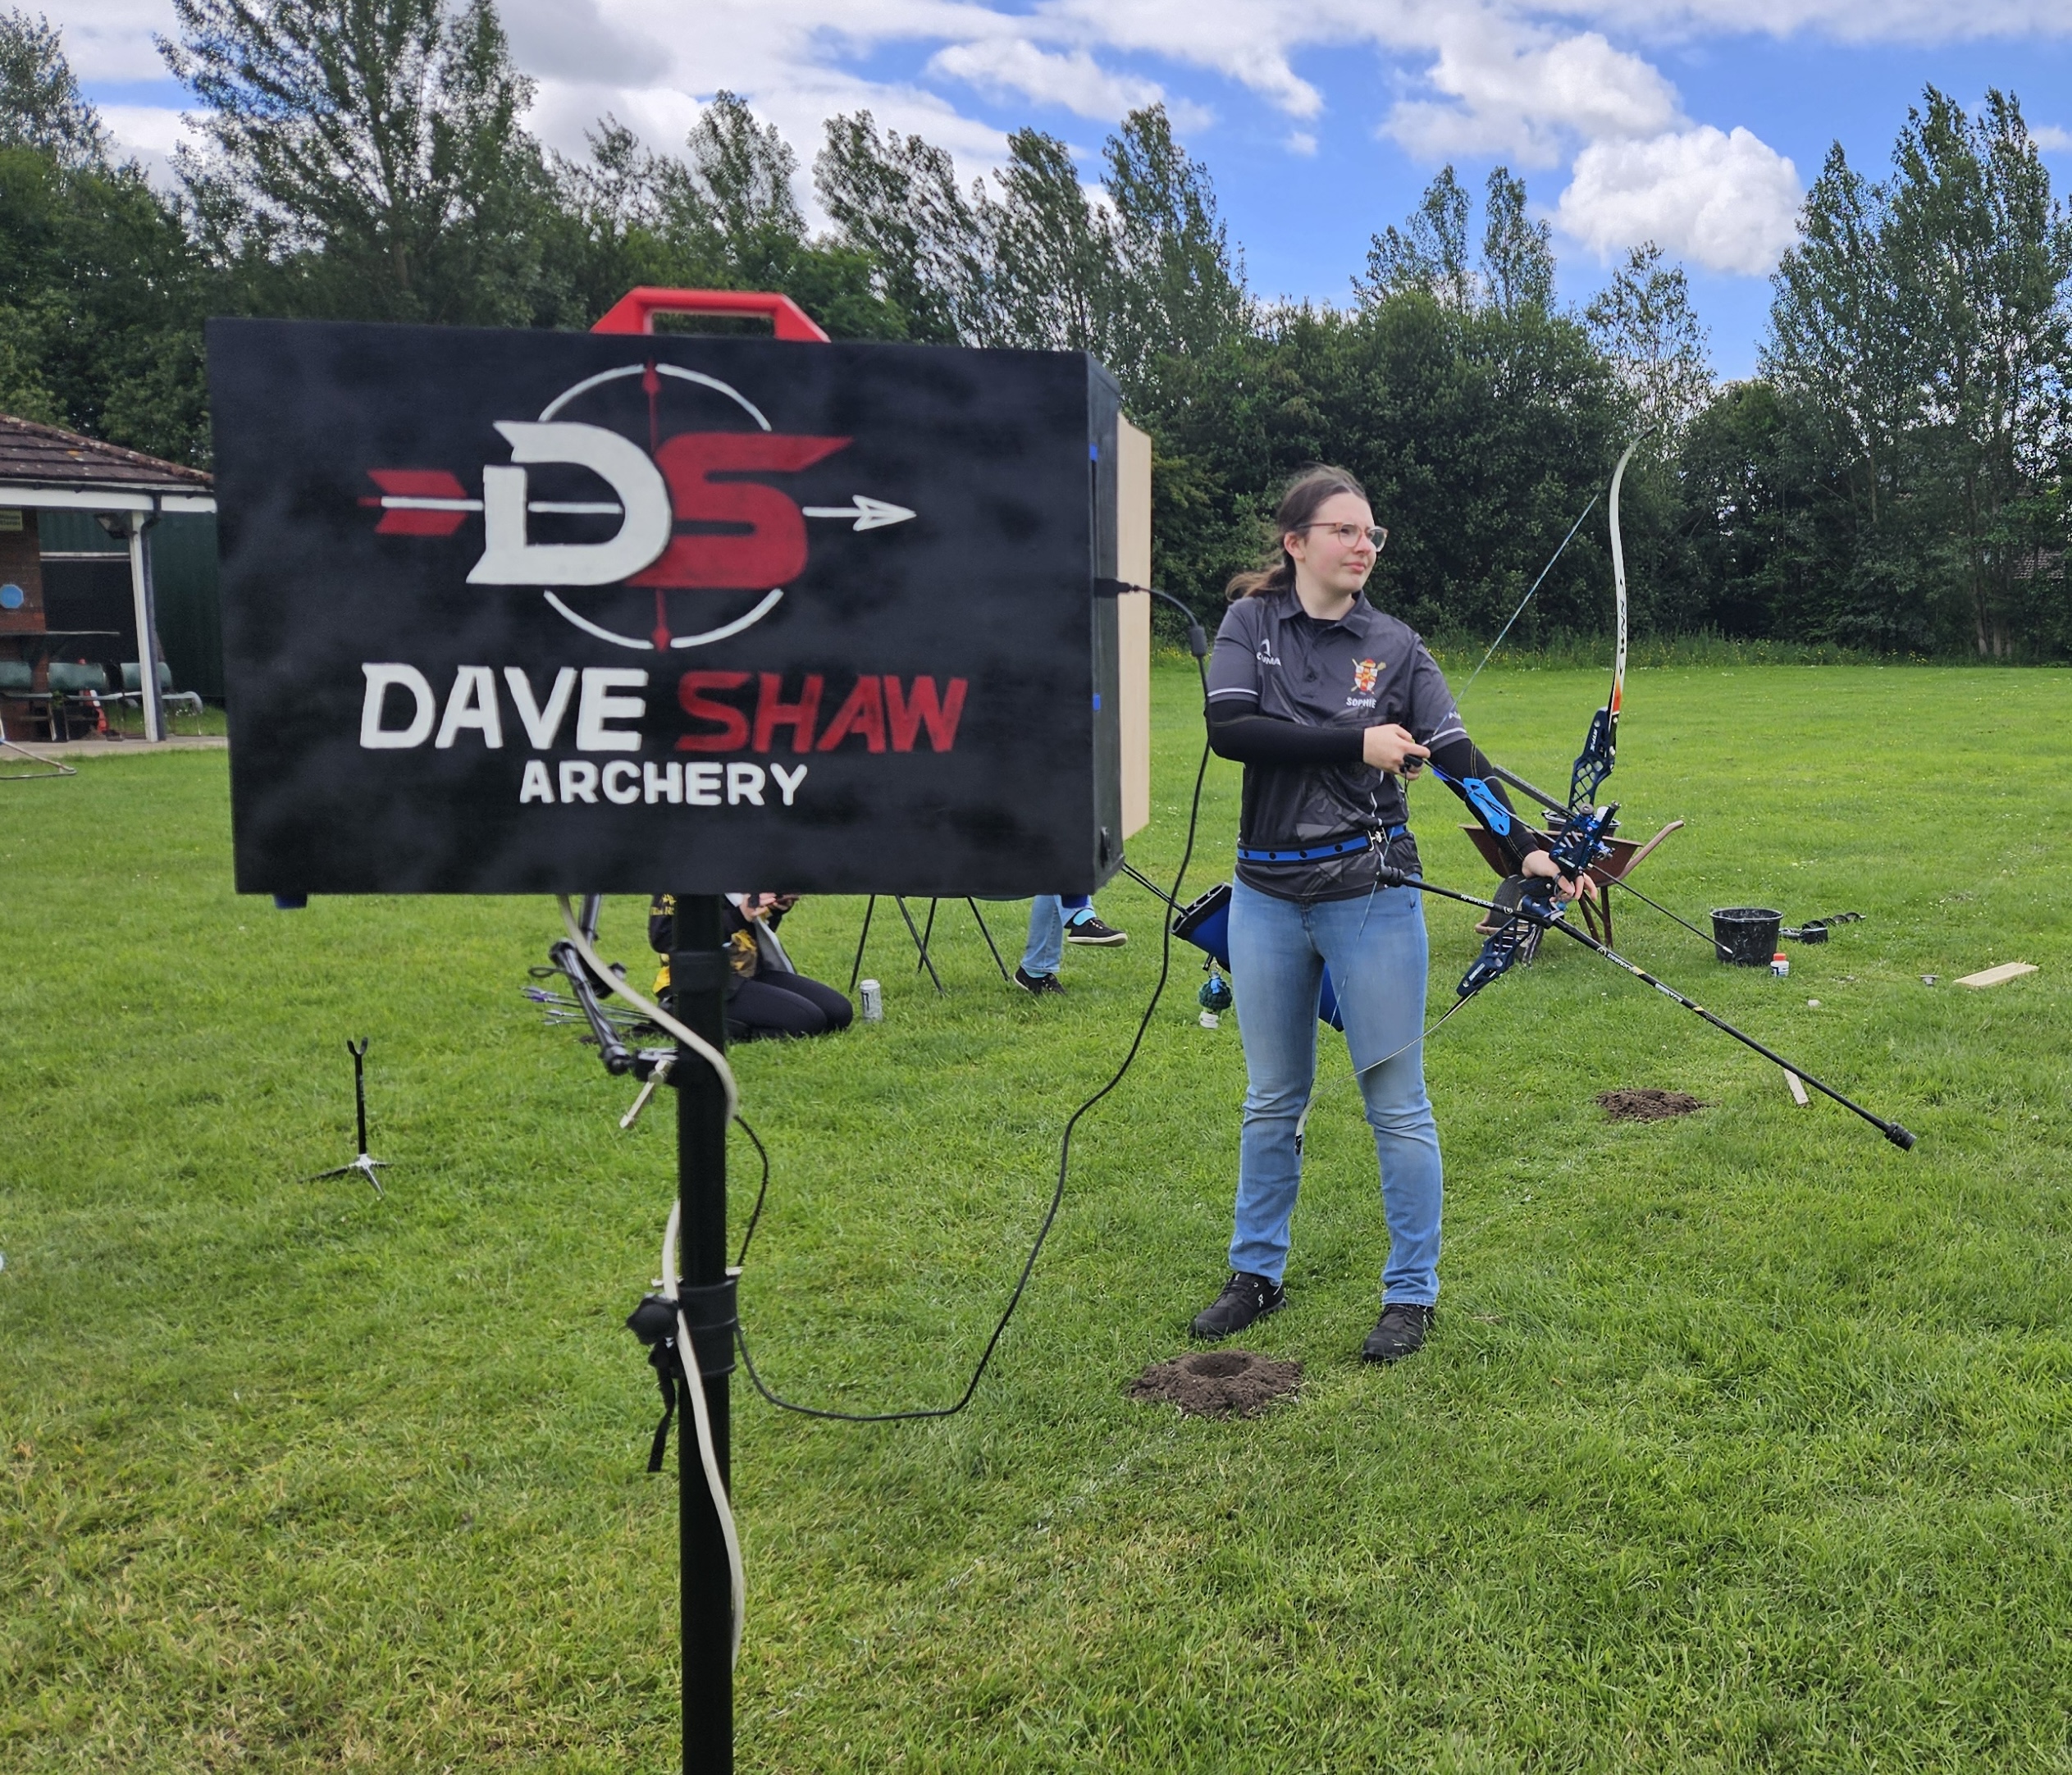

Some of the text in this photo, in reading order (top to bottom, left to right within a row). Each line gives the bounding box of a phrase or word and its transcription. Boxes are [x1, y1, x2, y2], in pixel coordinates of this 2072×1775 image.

[466, 420, 853, 590] DS
[359, 662, 969, 754] DAVE SHAW
[1346, 696, 1377, 709] SOPHIE
[519, 760, 809, 806] ARCHERY
